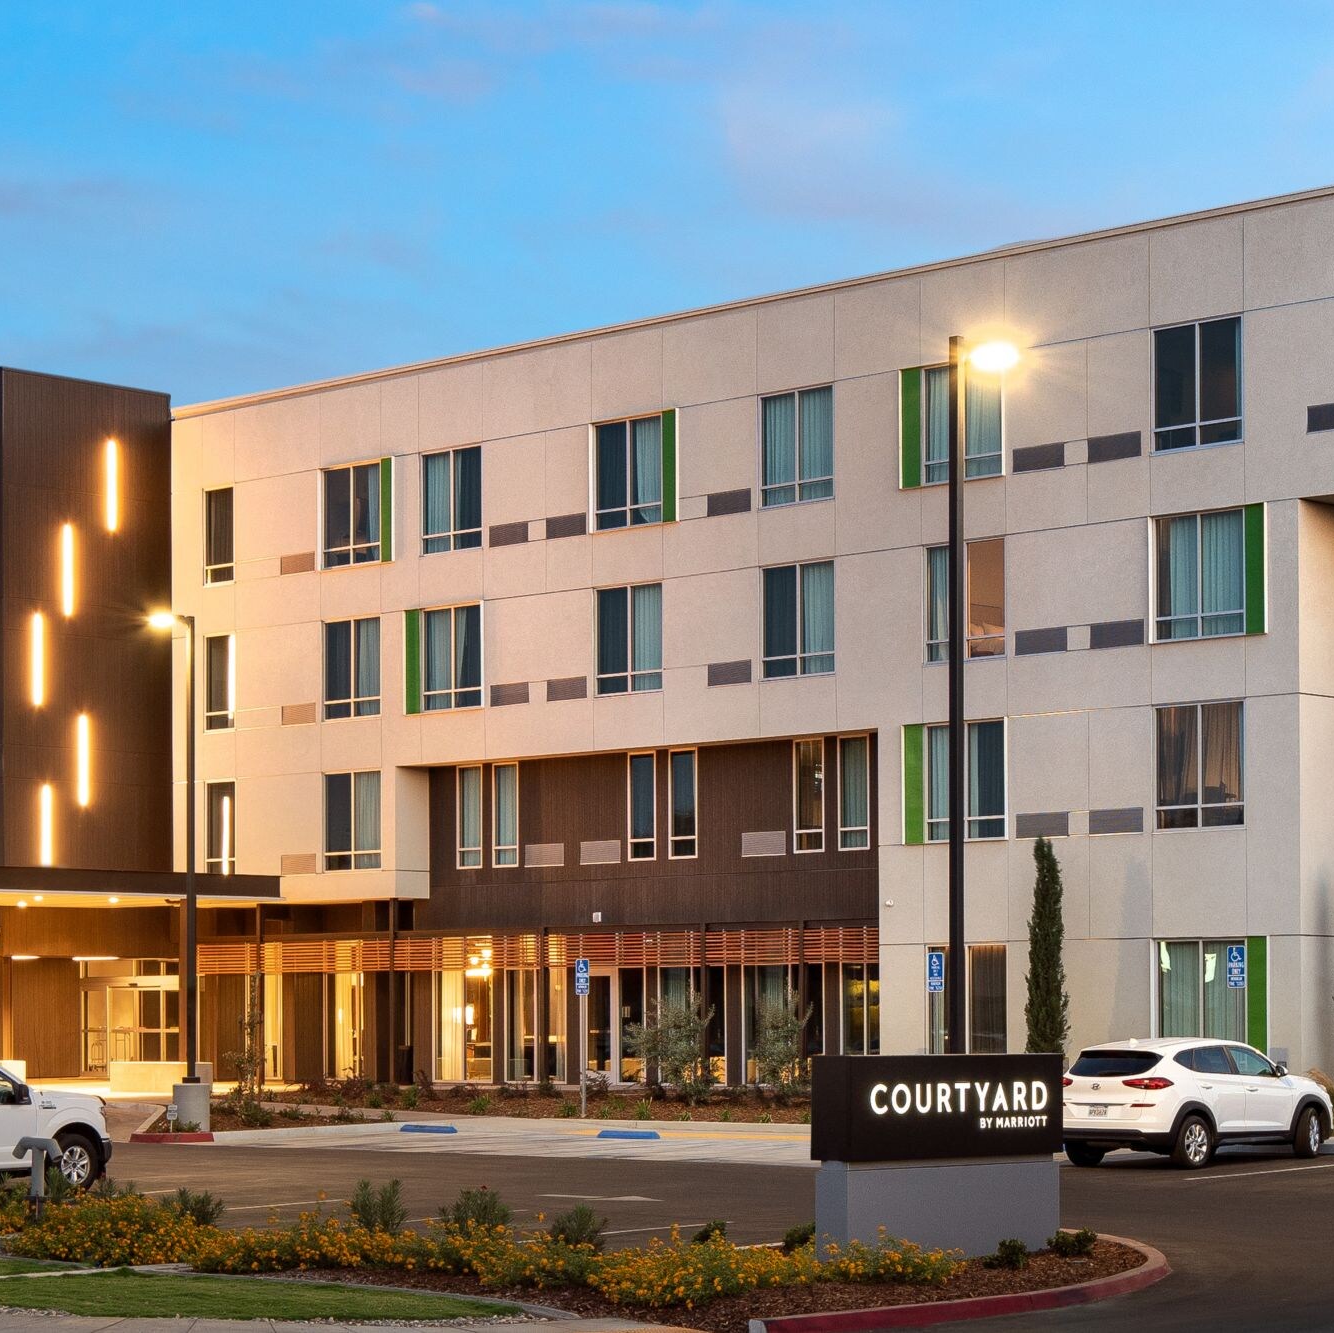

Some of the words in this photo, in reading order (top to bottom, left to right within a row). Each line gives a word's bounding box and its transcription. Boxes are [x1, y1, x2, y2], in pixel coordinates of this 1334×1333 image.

[870, 1081, 1048, 1115] COURTYARD
[979, 1117, 993, 1129] BY
[995, 1115, 1048, 1128] MARRIOTT
